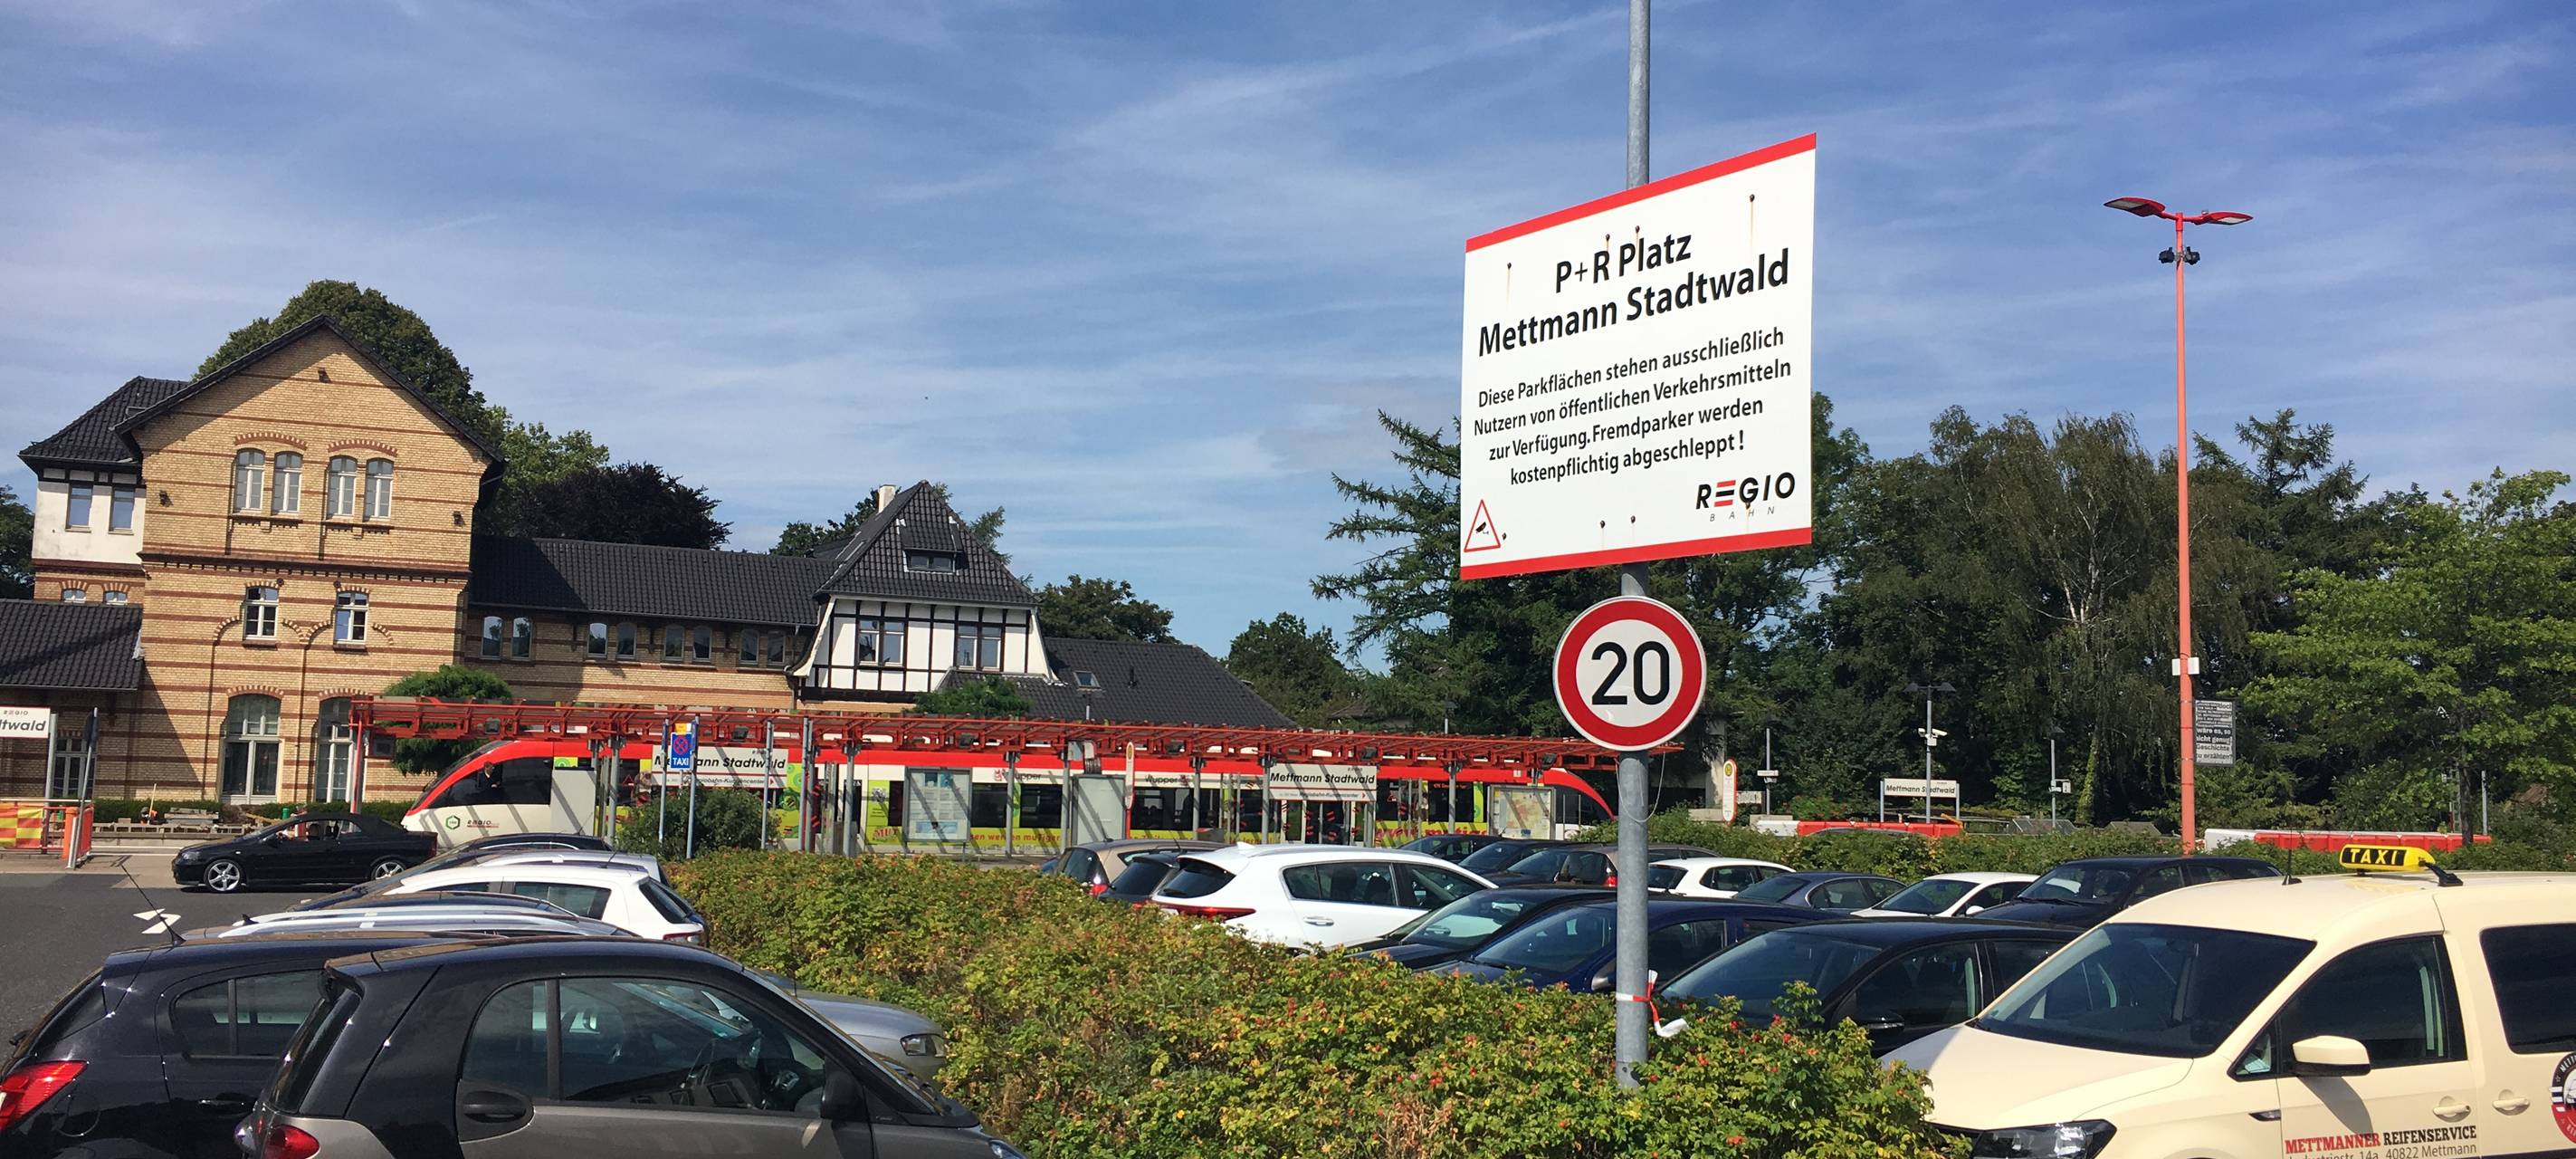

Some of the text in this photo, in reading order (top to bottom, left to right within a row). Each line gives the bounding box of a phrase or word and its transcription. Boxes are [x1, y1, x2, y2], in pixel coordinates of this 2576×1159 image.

[1618, 234, 1692, 277] Platz
[1479, 247, 1789, 358] Mettmann Stadtwald
[1478, 326, 1784, 408] Diese Parkflächen stehen ausschließlich
[1474, 358, 1791, 436] Nutzern von öffentlichen Verkehrsmitteln
[1489, 445, 1511, 461] zur
[1592, 410, 1694, 443] Fremdparker
[1698, 398, 1763, 424] werden
[1511, 453, 1619, 485] kostenpflichtig
[1623, 434, 1735, 470] abgeschleppt
[1695, 471, 1796, 510] REGIO
[1591, 640, 1670, 705] 20
[0, 719, 46, 732] twald
[654, 755, 786, 770] Mann Stadtwld
[672, 757, 689, 766] TAXI
[1270, 772, 1375, 784] Mettmann Stadtwald
[1885, 784, 1956, 794] Mettmann Sadtwald
[987, 834, 1021, 842] weren
[2350, 848, 2398, 865] TAXI
[2284, 1125, 2477, 1154] METTMANNER REIFENSERVICE
[2385, 1146, 2419, 1159] 40822
[2421, 1143, 2477, 1158] Mettmann
